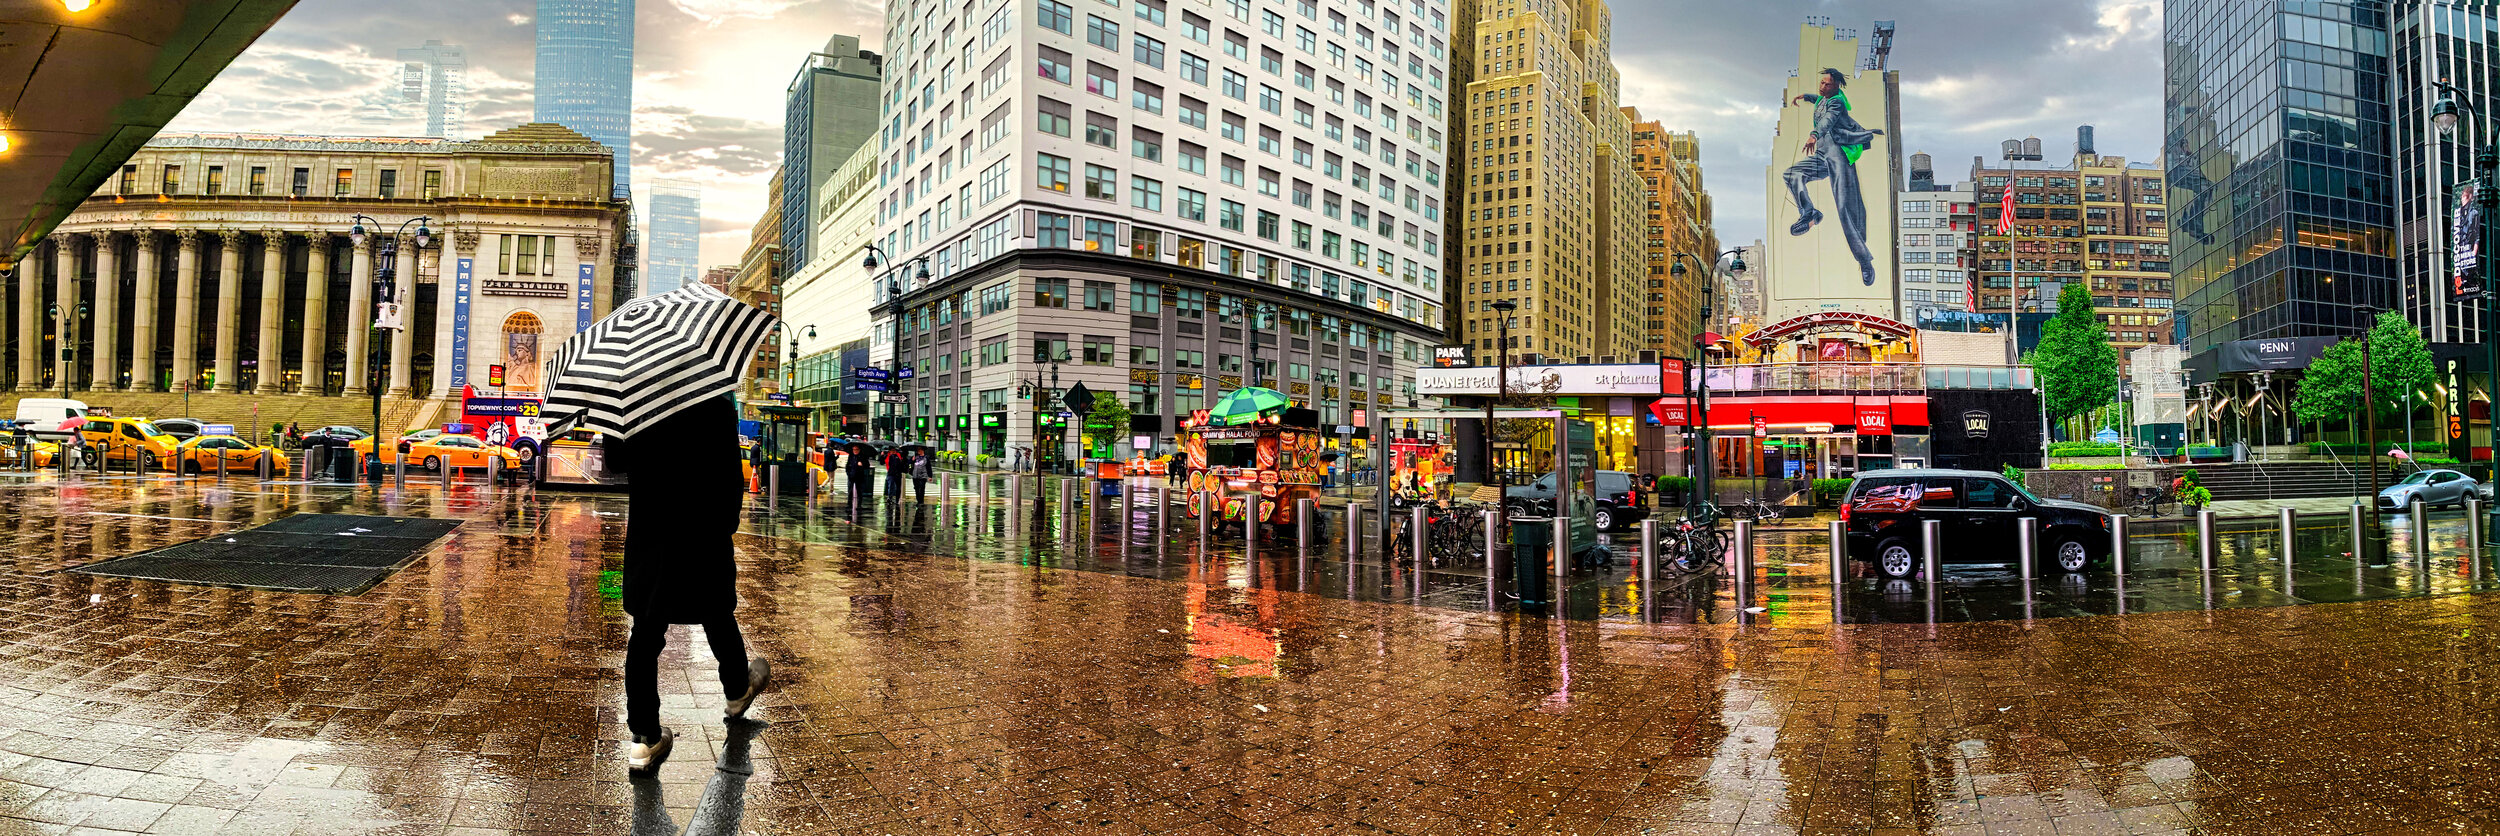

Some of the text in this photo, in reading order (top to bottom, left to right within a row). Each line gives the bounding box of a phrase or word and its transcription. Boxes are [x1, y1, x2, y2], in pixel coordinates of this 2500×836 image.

[253, 212, 266, 220] OF
[272, 212, 307, 220] THEIR
[2460, 258, 2476, 267] STORE
[487, 280, 564, 291] PENN STATION
[580, 267, 591, 310] PENN
[453, 261, 470, 385] PENN STATION
[1435, 347, 1465, 358] PARK
[2260, 341, 2296, 353] PENN 1
[858, 370, 875, 378] Eighth
[1465, 370, 1508, 388] read
[2448, 360, 2459, 416] PARK
[518, 404, 539, 417] $29
[1666, 411, 1685, 420] LOCAL
[1861, 415, 1886, 427] LOCAL
[1966, 418, 1988, 431] LOCAL
